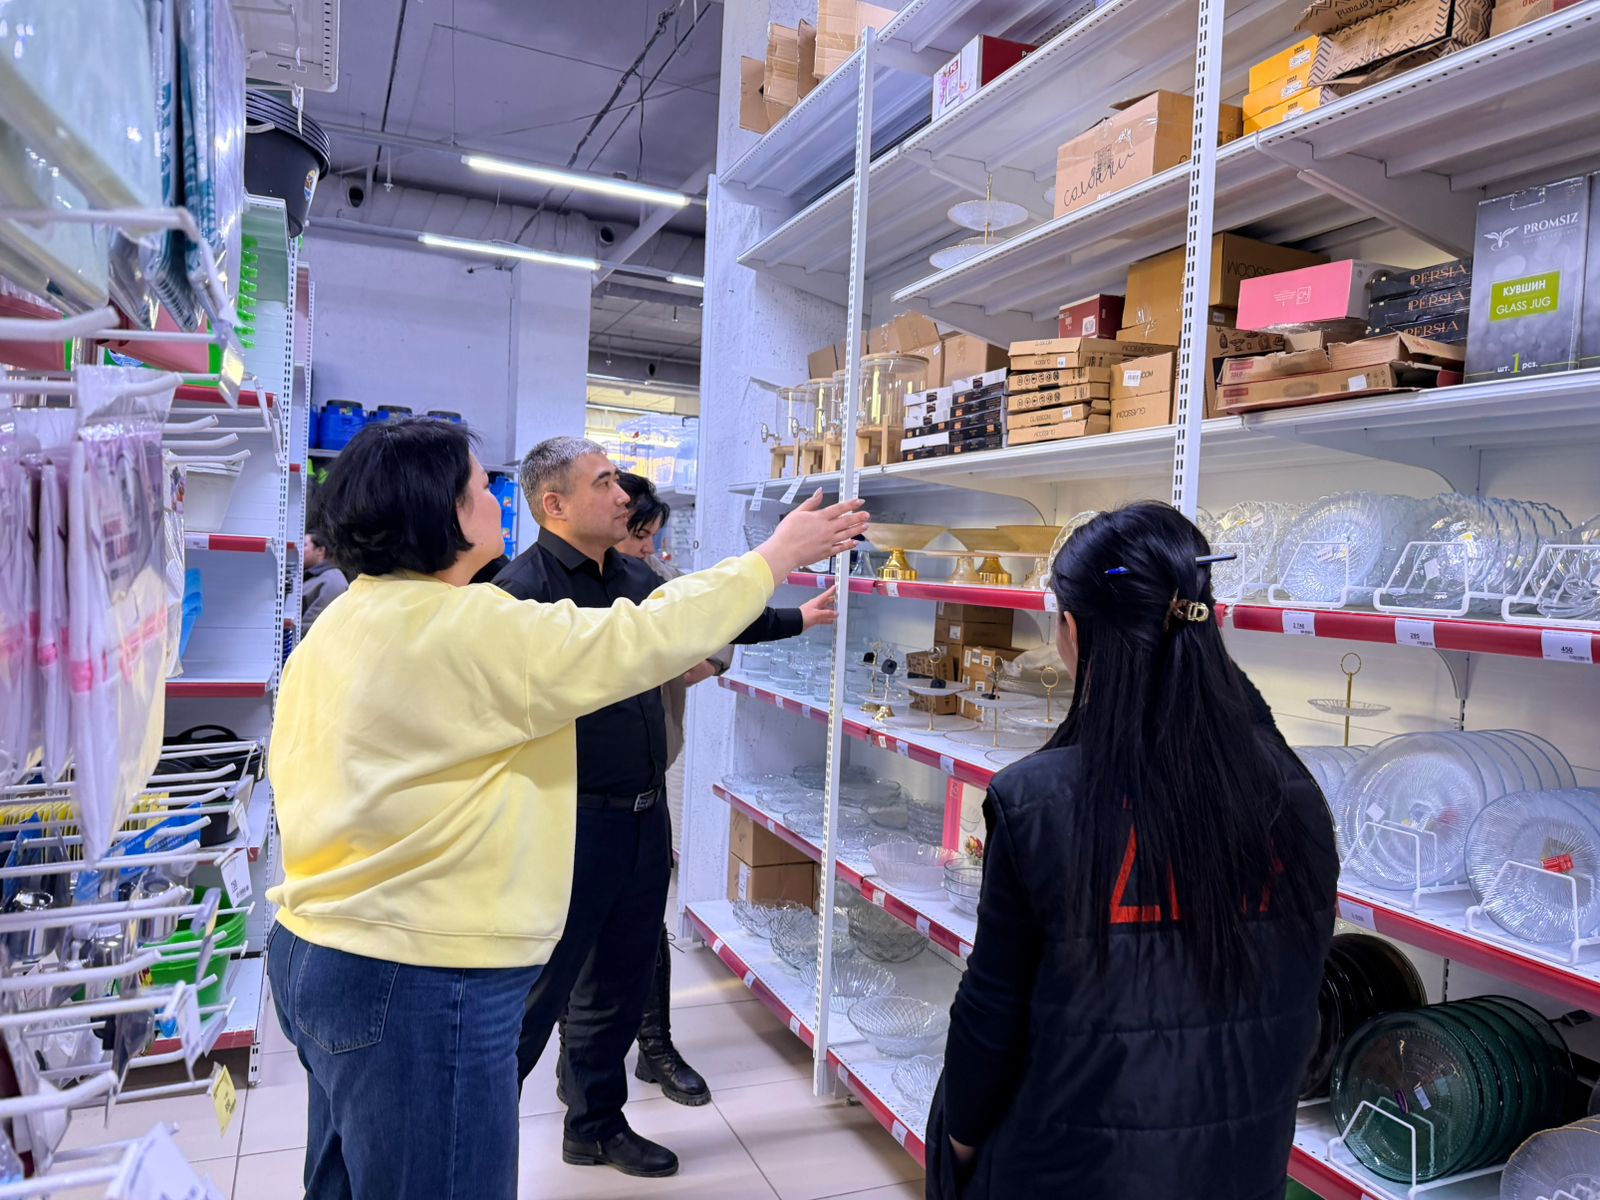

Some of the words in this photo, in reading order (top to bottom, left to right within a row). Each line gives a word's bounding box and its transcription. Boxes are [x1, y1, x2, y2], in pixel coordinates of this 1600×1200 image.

[1523, 212, 1579, 235] PROMSIZ
[1410, 264, 1467, 286] PERSIA
[1502, 279, 1546, 297] КУВШИН
[1408, 290, 1465, 311] PERSIA
[1496, 301, 1527, 315] GLASS
[1529, 296, 1551, 310] JUG
[1497, 365, 1510, 373] шт.
[1511, 352, 1521, 374] 1
[1522, 361, 1538, 371] pcs.
[1560, 645, 1574, 654] 450
